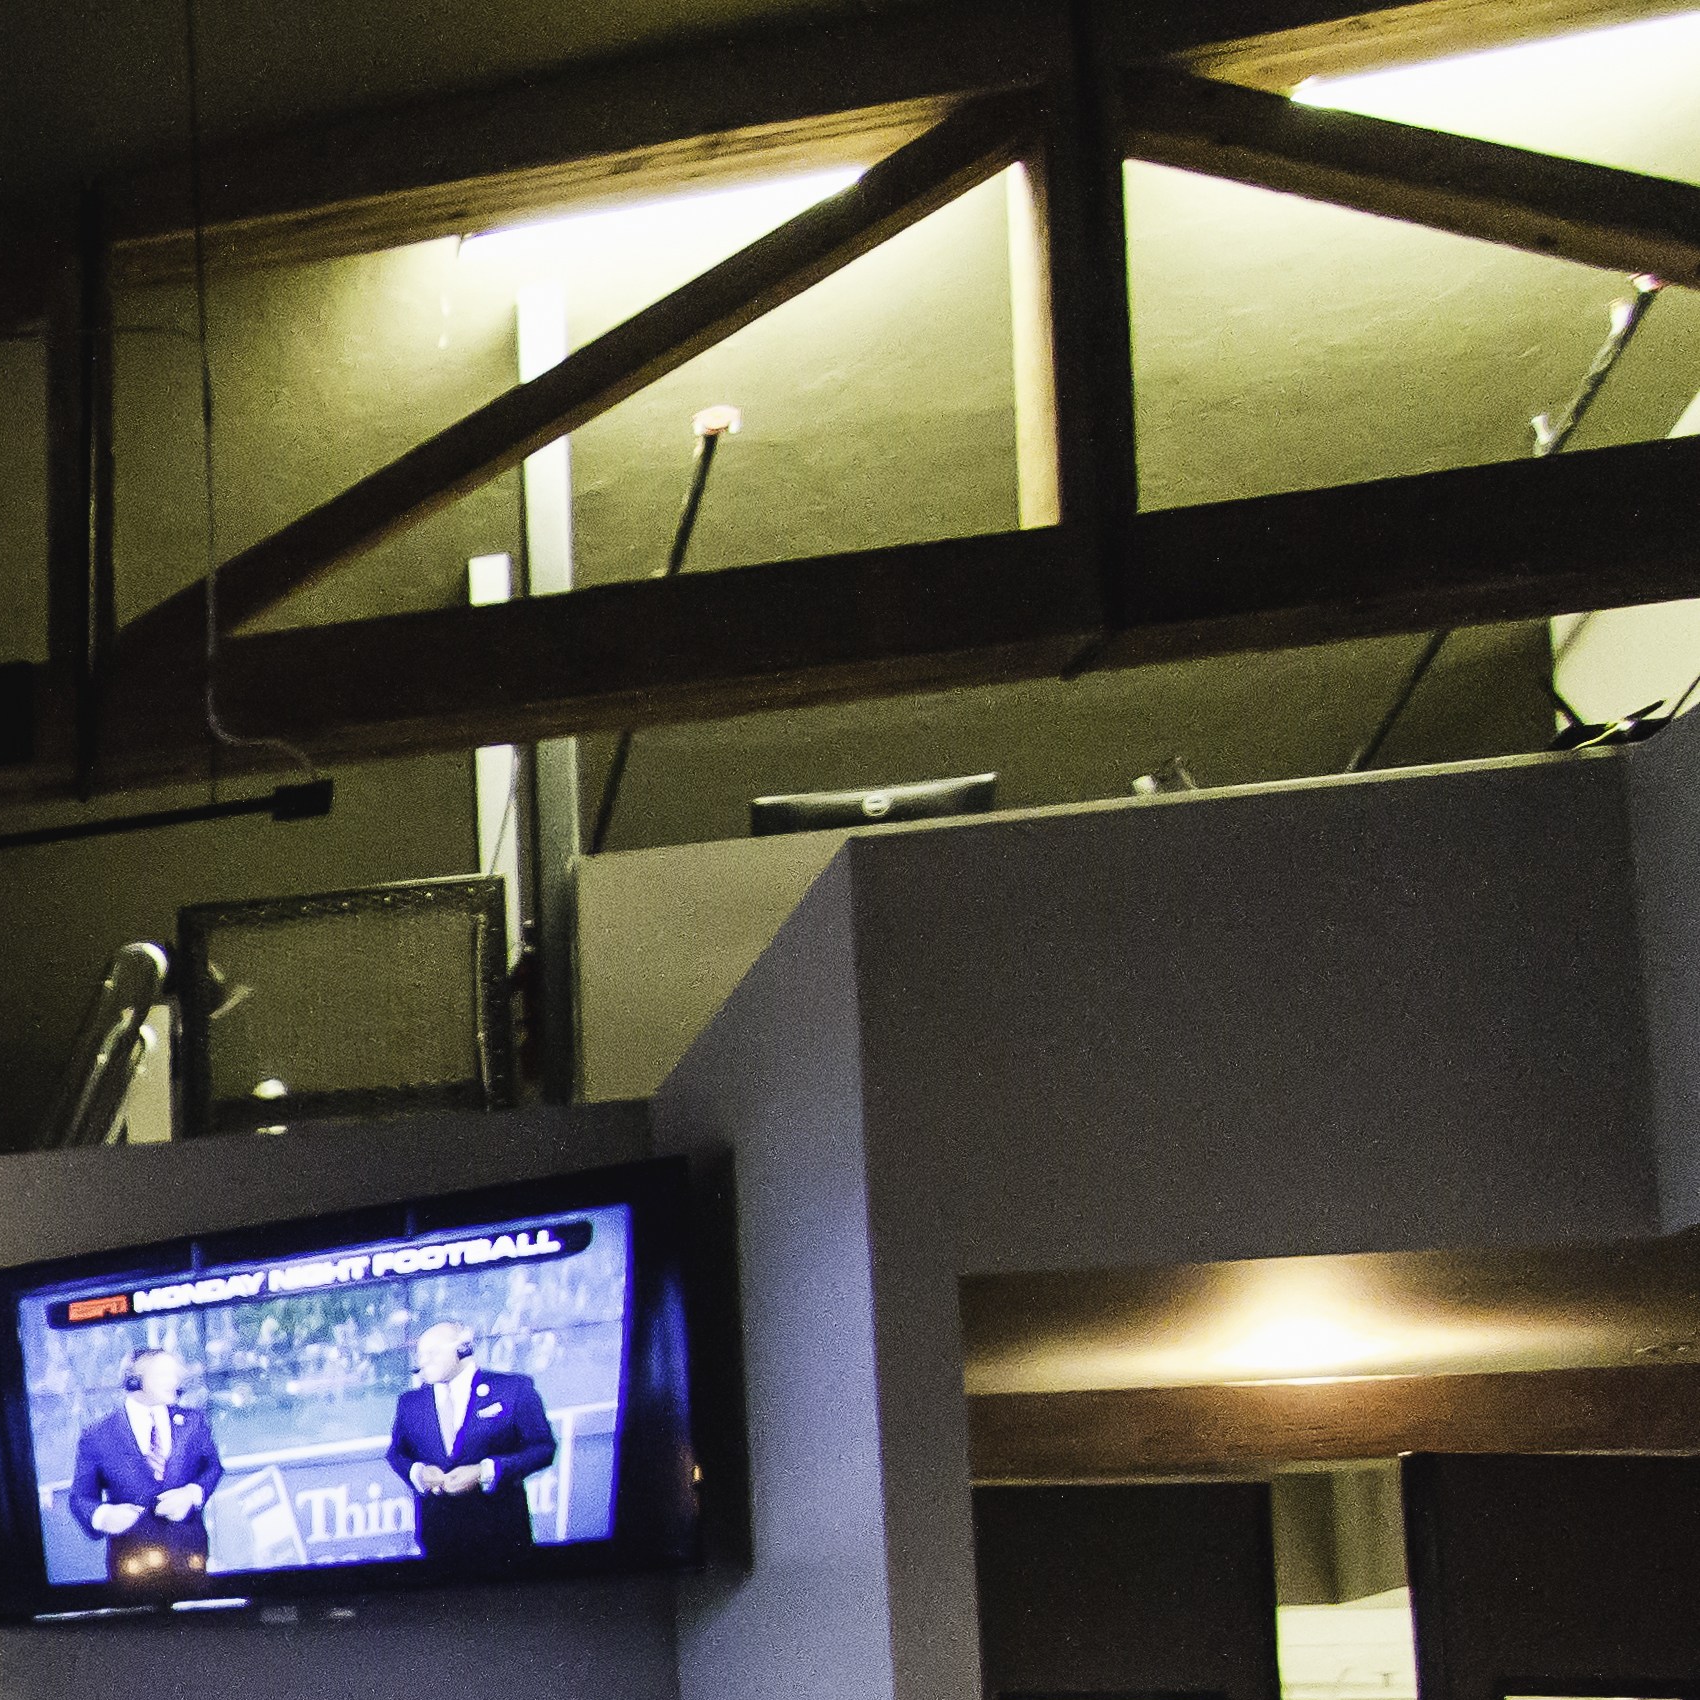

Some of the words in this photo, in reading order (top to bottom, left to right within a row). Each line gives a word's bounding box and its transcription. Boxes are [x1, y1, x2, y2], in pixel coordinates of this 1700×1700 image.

[68, 1294, 129, 1321] ESPN
[132, 1271, 266, 1313] MONDAY
[266, 1254, 373, 1292] NIGHT
[372, 1229, 563, 1277] FOOTBALL
